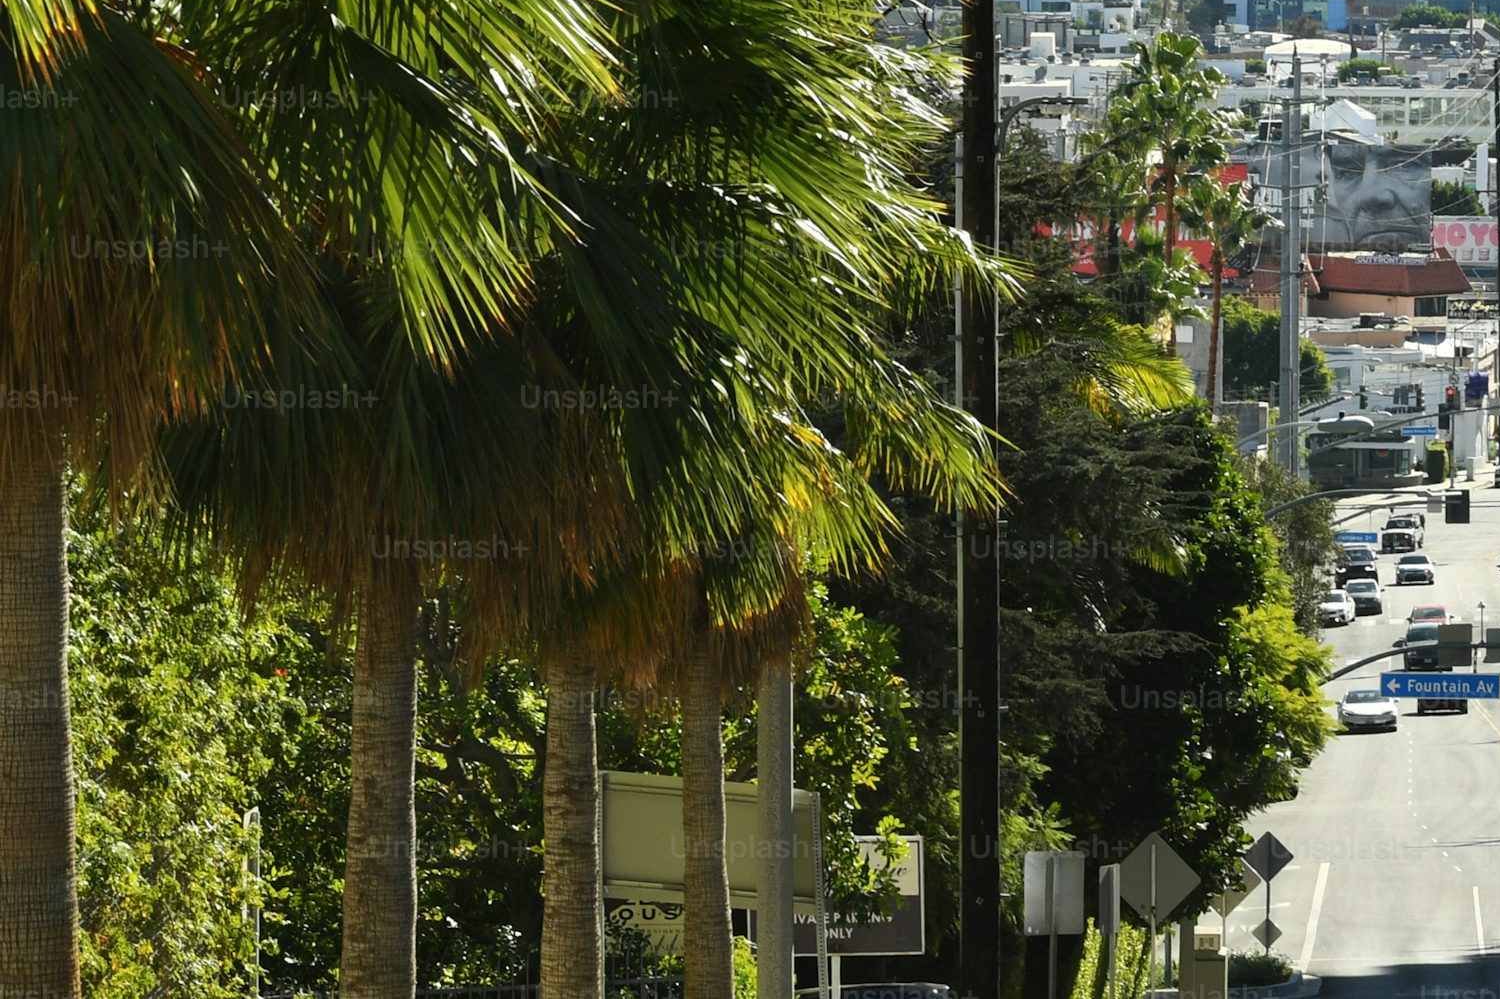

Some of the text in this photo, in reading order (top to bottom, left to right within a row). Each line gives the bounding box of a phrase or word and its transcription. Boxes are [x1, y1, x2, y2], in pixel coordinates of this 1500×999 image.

[1407, 679, 1494, 693] Fountain Av
[793, 911, 893, 925] IVAE PRING
